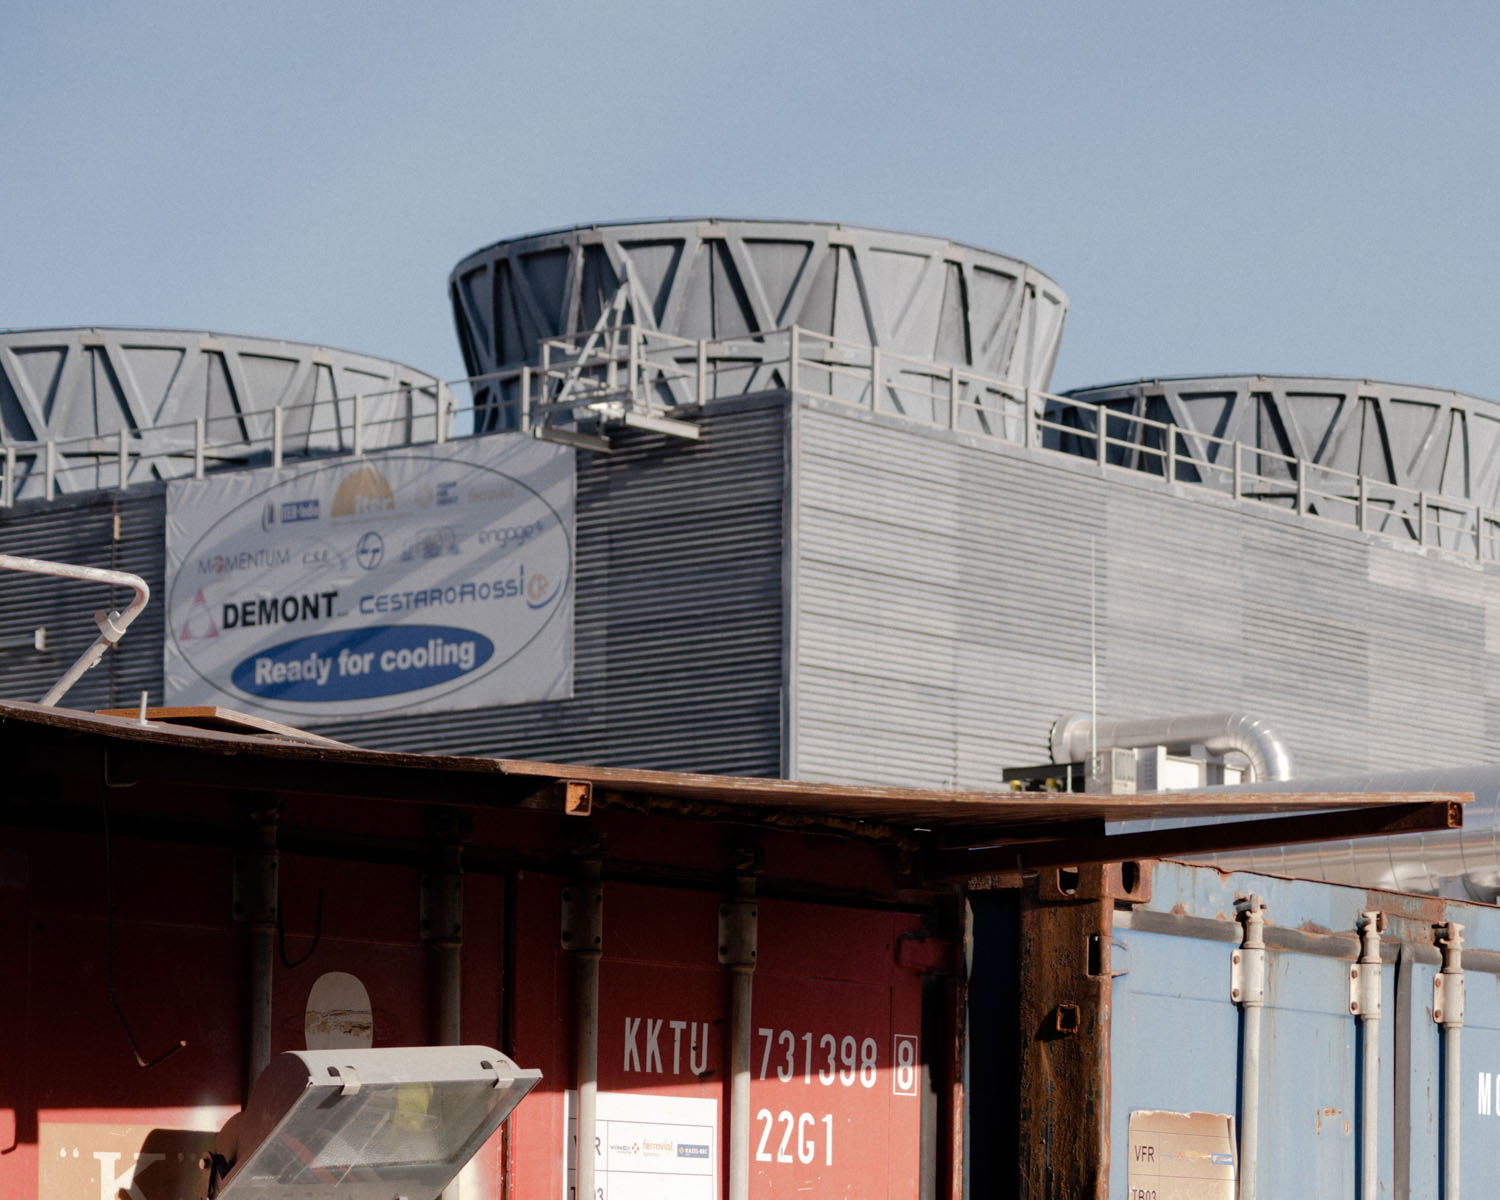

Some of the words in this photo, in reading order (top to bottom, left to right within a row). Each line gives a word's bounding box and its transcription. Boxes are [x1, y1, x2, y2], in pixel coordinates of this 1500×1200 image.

[222, 591, 338, 630] DEMONT
[255, 652, 332, 686] Ready
[338, 649, 372, 675] for
[381, 640, 477, 672] cooling
[623, 1017, 709, 1076] KKTU
[758, 1028, 878, 1089] 731398
[755, 1108, 833, 1166] 22G1
[1134, 1145, 1155, 1162] VFR
